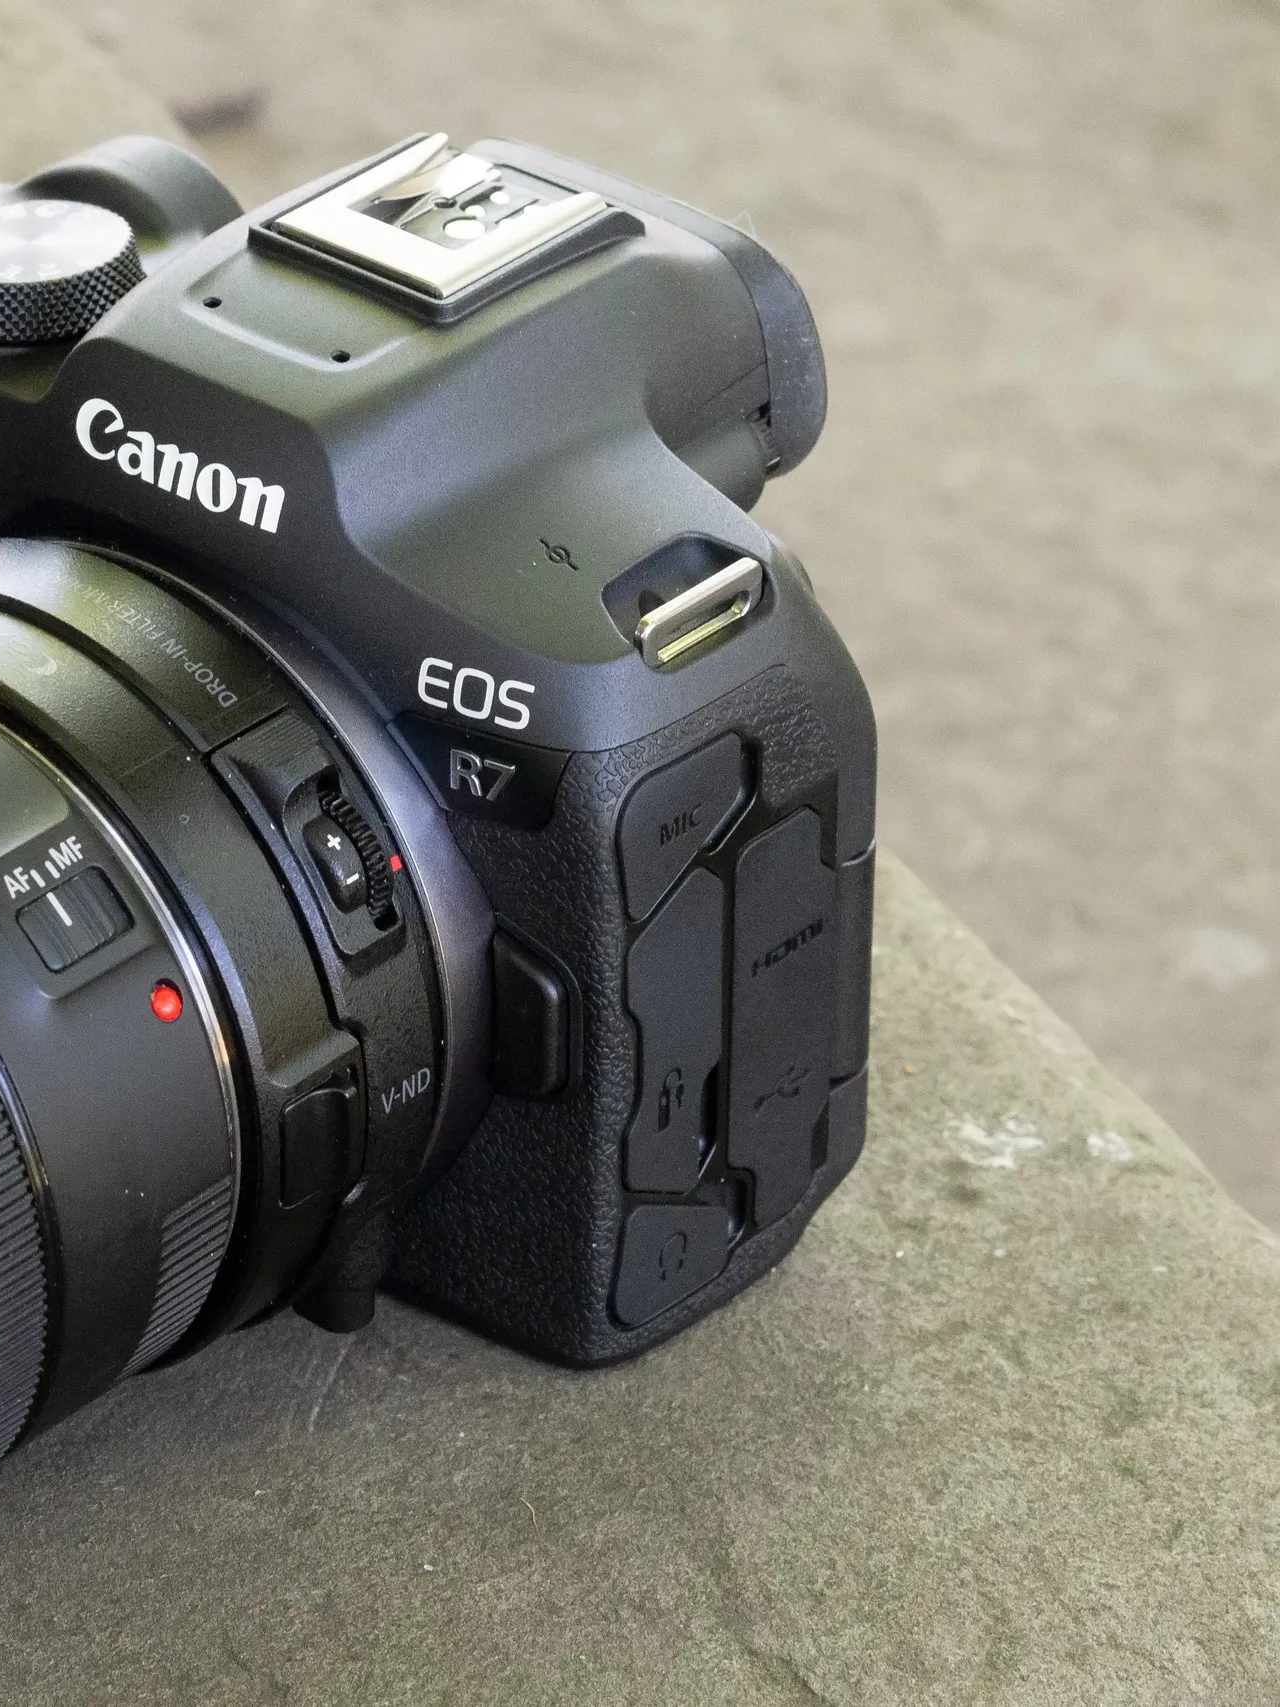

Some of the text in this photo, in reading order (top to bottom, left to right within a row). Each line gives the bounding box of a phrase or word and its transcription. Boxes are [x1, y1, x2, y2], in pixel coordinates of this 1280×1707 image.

[76, 397, 286, 534] Canon
[160, 637, 239, 709] DROP-IN
[417, 656, 536, 730] EOS
[449, 748, 517, 801] R7
[659, 802, 704, 848] MIC
[47, 835, 84, 871] MF
[3, 866, 31, 899] AF
[751, 917, 825, 977] HDMI
[380, 1066, 432, 1114] V-ND
